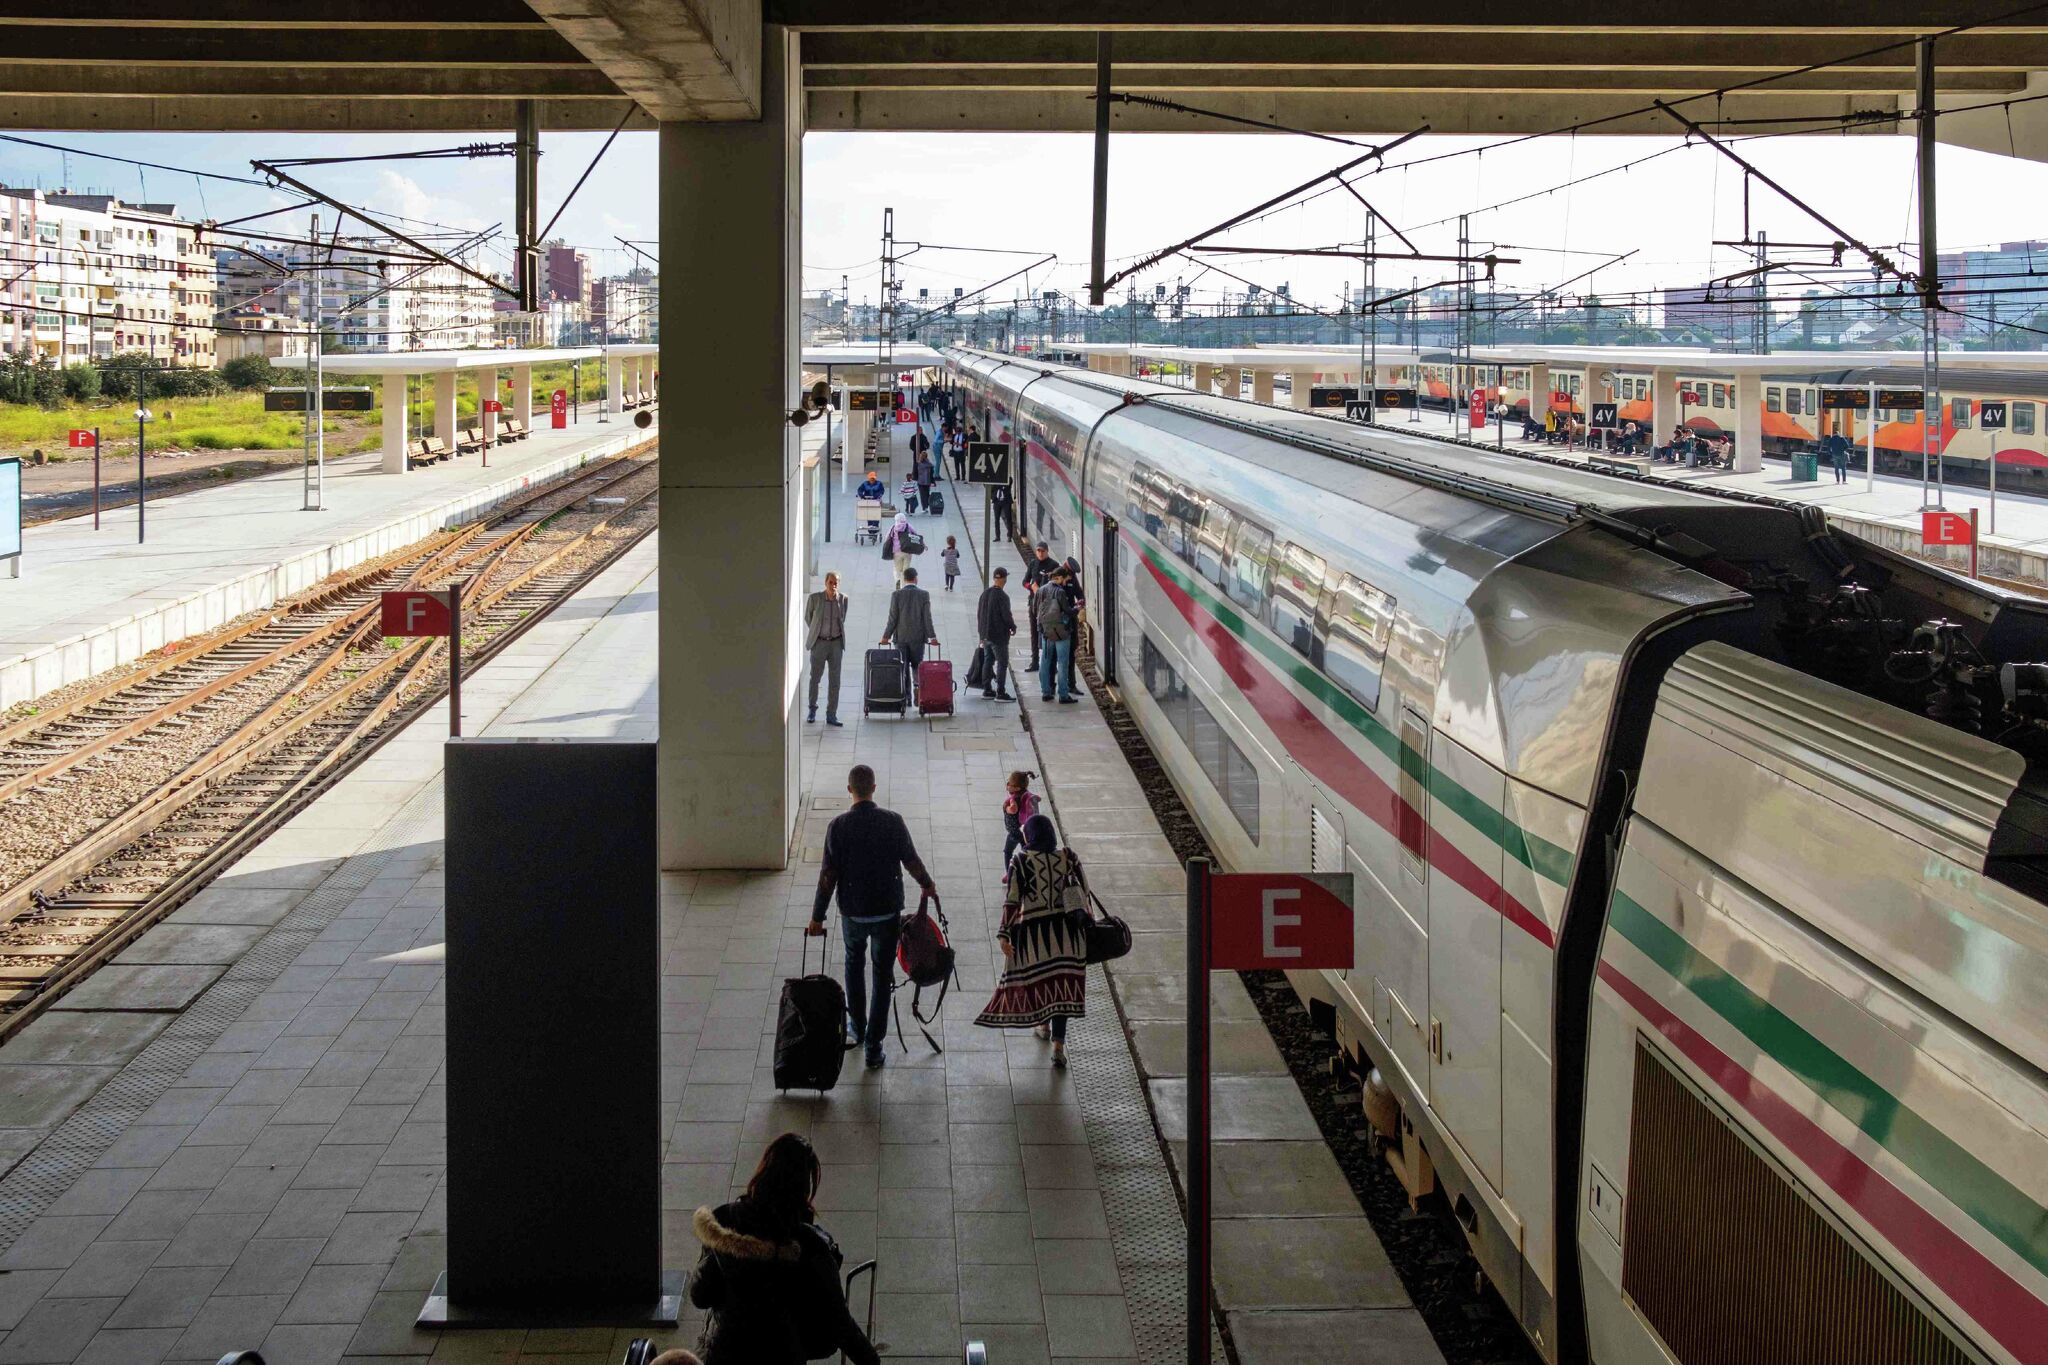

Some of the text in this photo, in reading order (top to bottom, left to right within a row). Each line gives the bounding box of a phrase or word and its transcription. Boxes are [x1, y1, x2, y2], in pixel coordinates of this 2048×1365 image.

[1559, 394, 1566, 402] D
[1689, 394, 1696, 402] D
[491, 402, 496, 411] F
[902, 412, 911, 421] D
[1350, 407, 1367, 420] 4V
[1595, 409, 1613, 422] 4V
[1984, 409, 2003, 422] 4V
[79, 432, 87, 445] F
[974, 453, 1004, 474] 4V
[1941, 517, 1954, 541] E
[407, 598, 426, 632] F
[1262, 888, 1302, 958] E
